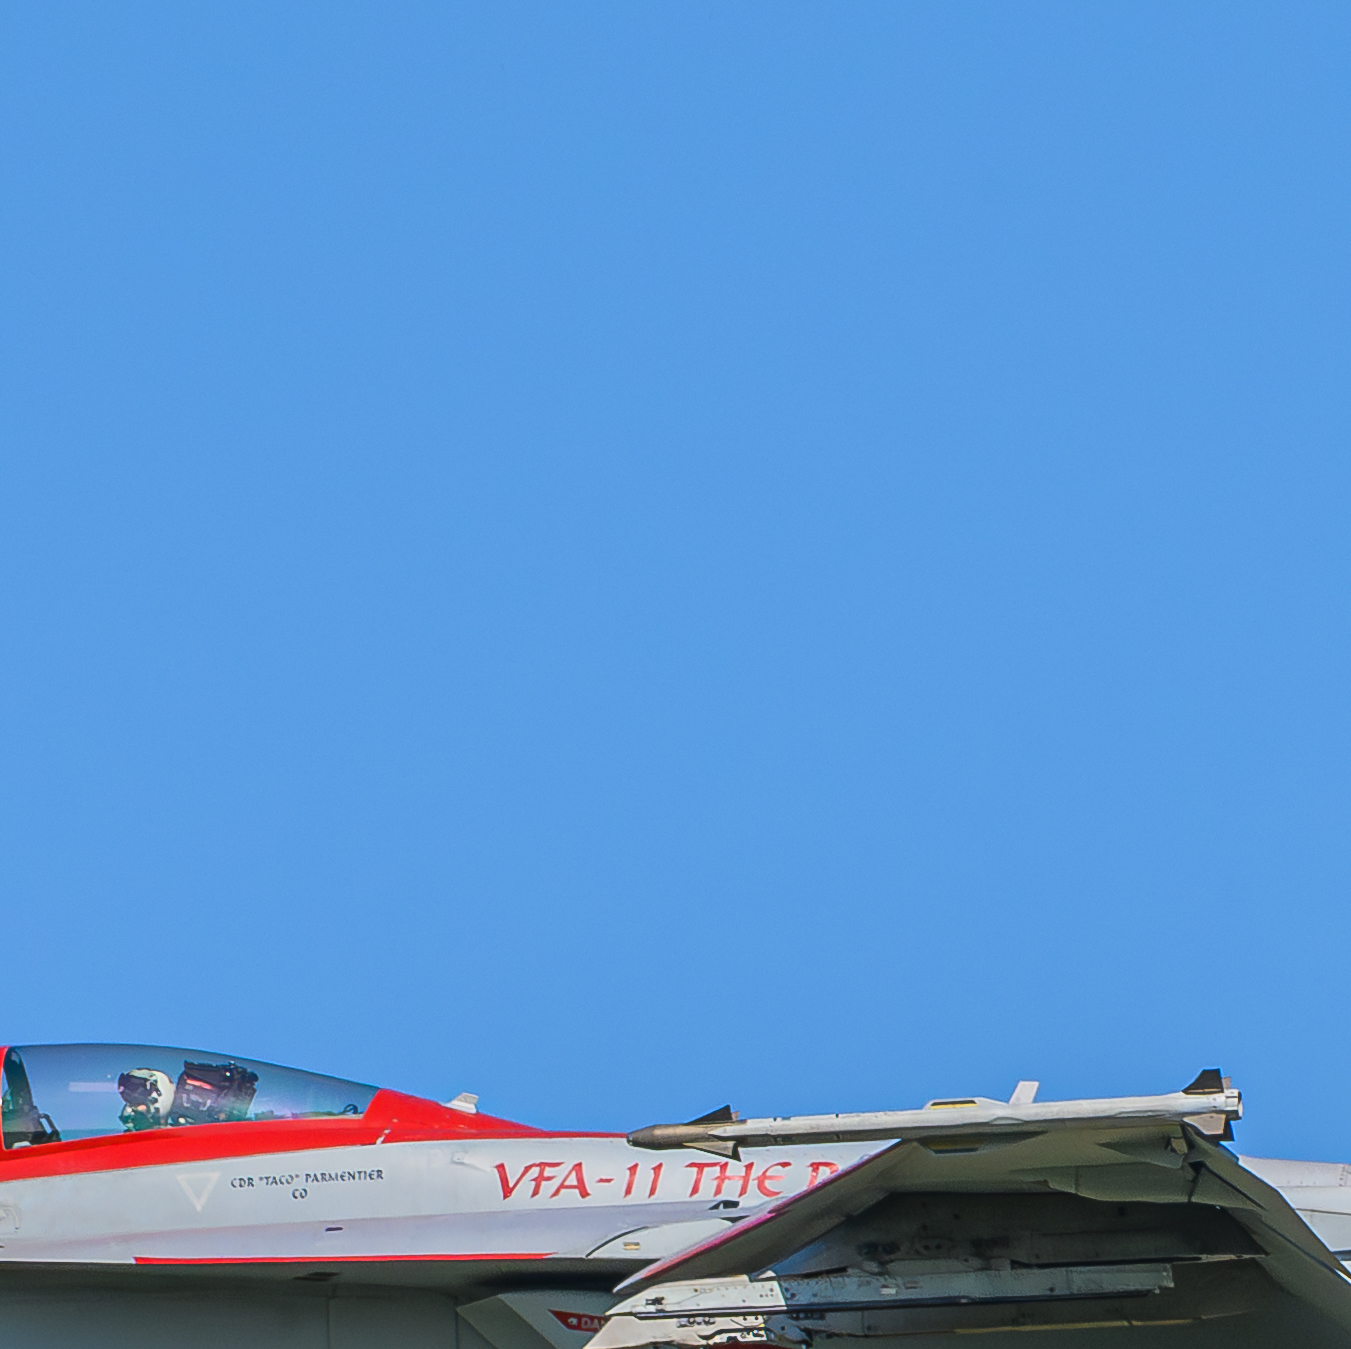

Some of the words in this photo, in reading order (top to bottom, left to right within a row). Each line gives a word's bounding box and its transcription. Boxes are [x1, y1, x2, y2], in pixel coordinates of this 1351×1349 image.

[230, 1177, 255, 1188] CDR
[305, 1169, 384, 1184] PARMENTIER
[493, 1161, 664, 1200] VFA-11
[684, 1161, 792, 1198] THE
[291, 1188, 308, 1199] CO
